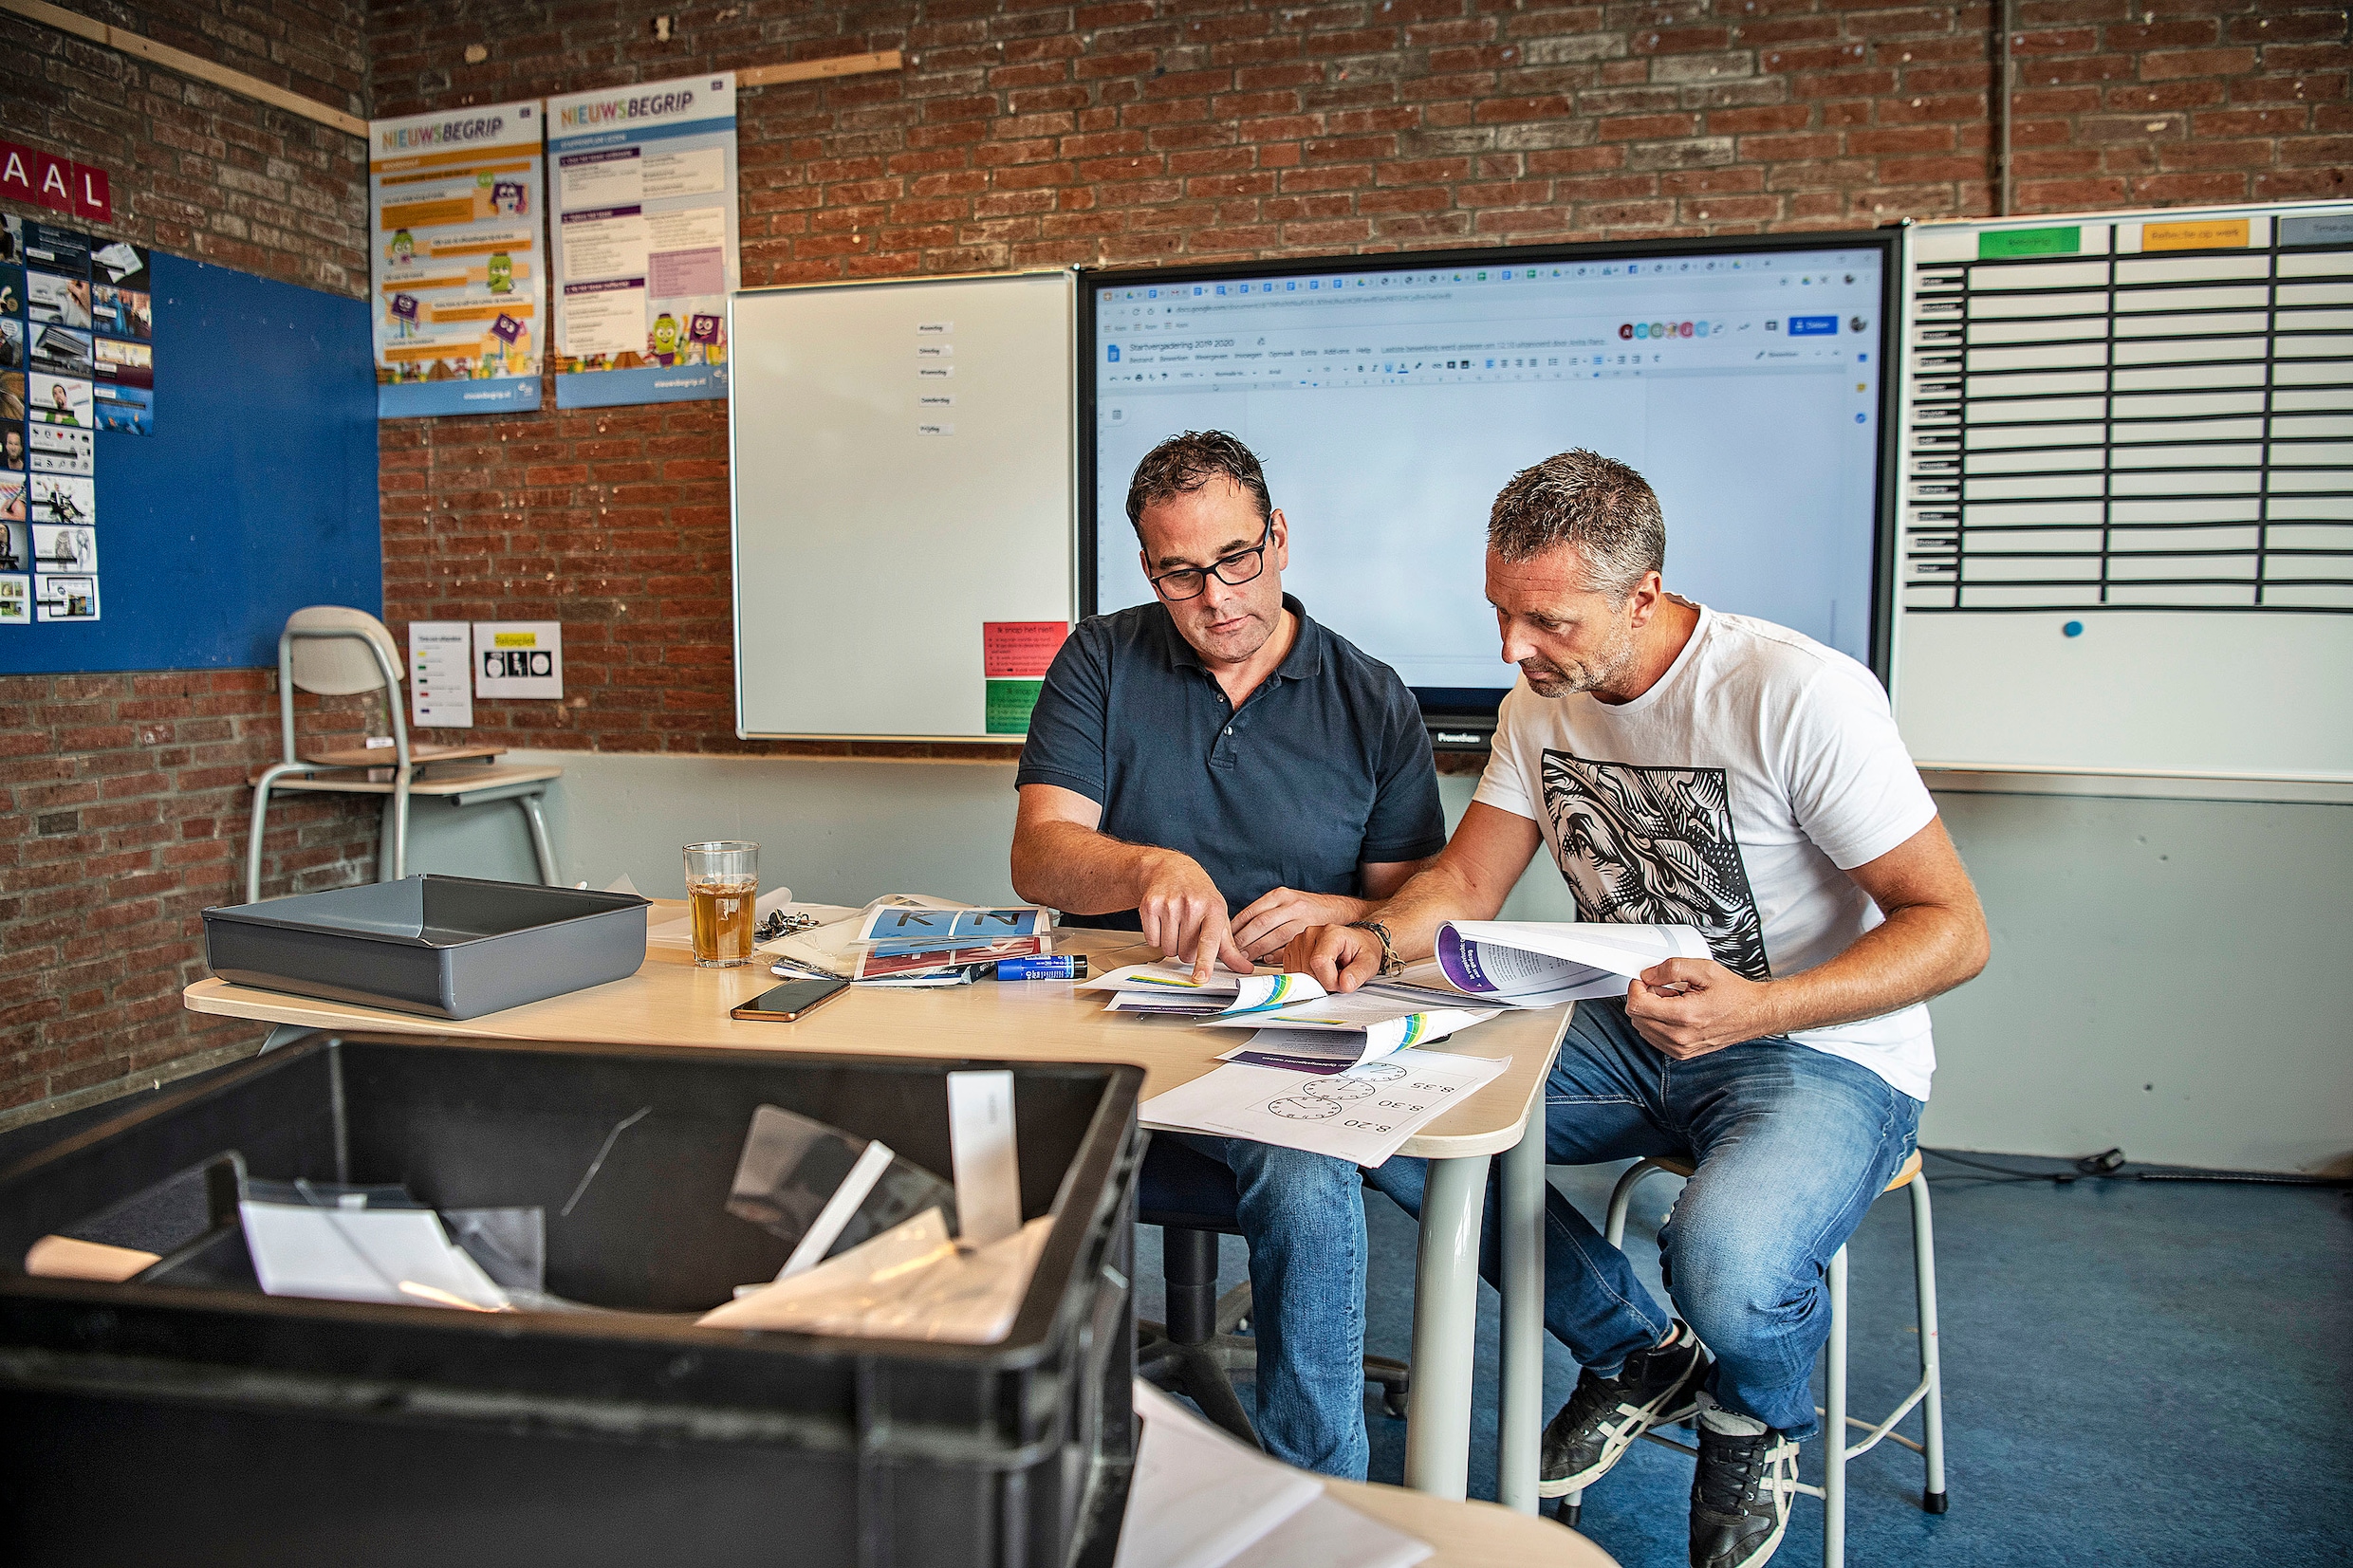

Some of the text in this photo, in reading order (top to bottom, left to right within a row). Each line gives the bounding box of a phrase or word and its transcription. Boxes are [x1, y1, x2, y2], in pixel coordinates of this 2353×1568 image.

[560, 91, 695, 127] NIEUWSBEGRIP
[381, 116, 503, 150] NIEUWSBEGRIP
[1129, 341, 1193, 353] Startvergadering
[1214, 339, 1235, 348] 2020
[1410, 1081, 1455, 1094] 8.35
[1378, 1099, 1424, 1112] 8.30
[1343, 1119, 1392, 1133] 8.20
